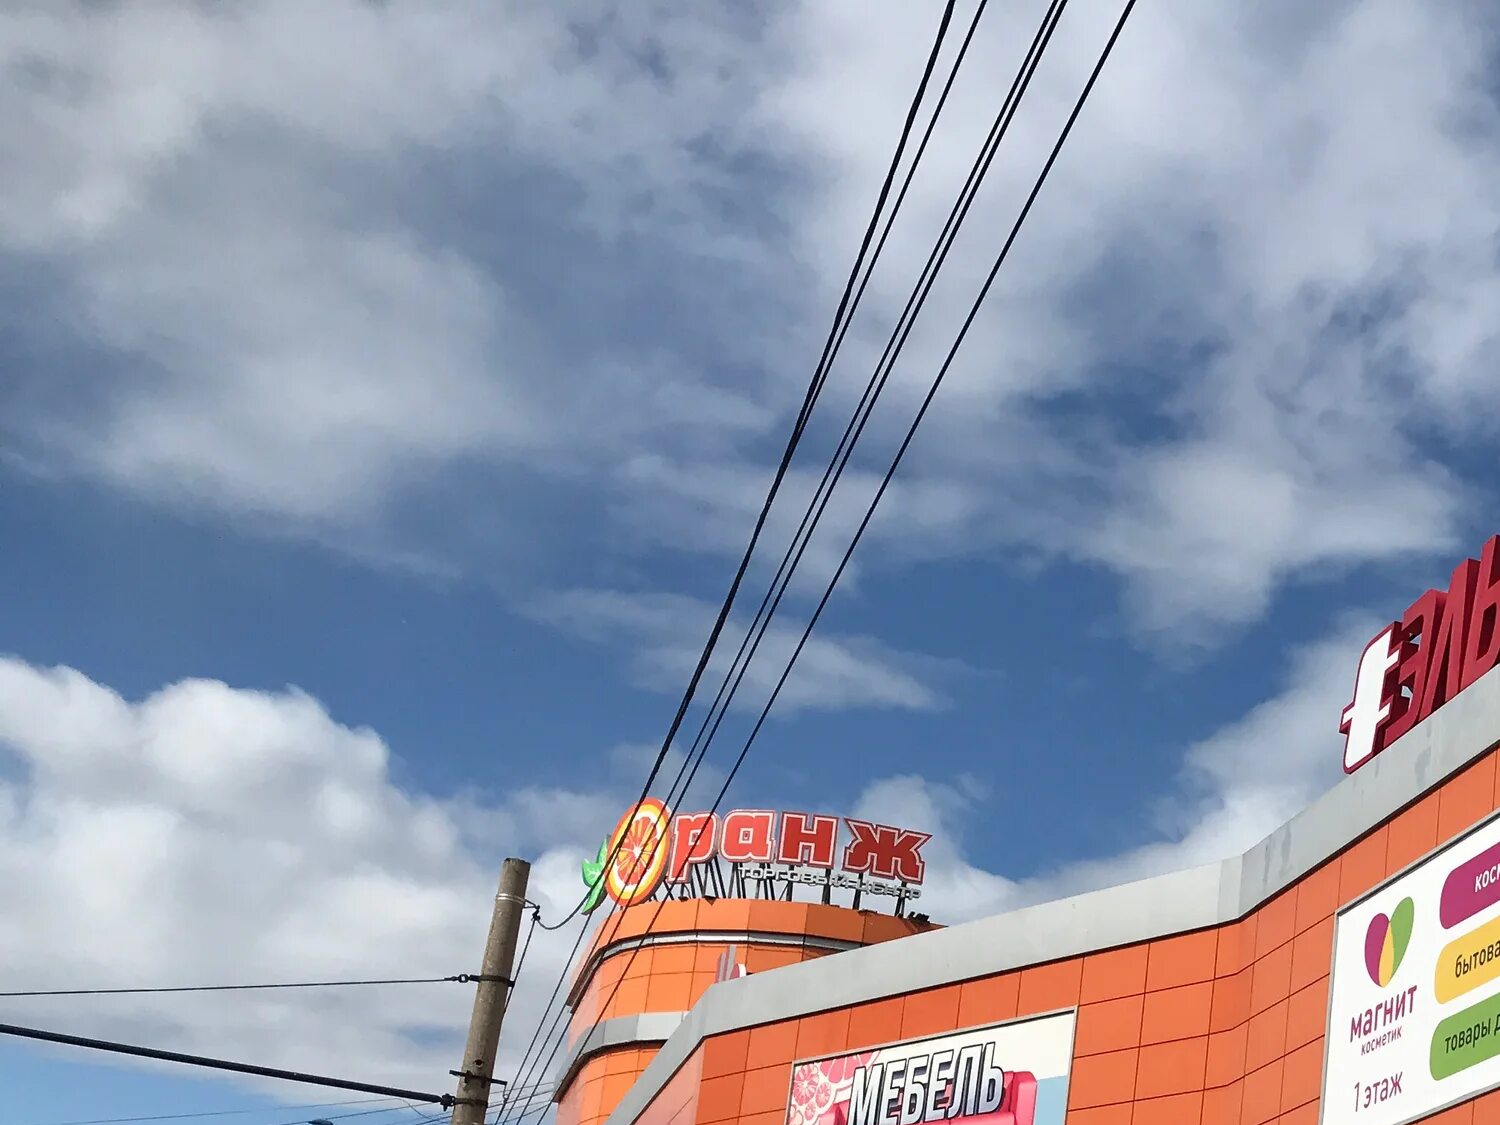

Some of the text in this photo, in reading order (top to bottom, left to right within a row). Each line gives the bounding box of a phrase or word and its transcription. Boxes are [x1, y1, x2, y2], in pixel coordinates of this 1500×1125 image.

[1360, 1024, 1403, 1057] косметик
[1445, 1021, 1491, 1054] товары
[1353, 1068, 1404, 1113] 1 этаж
